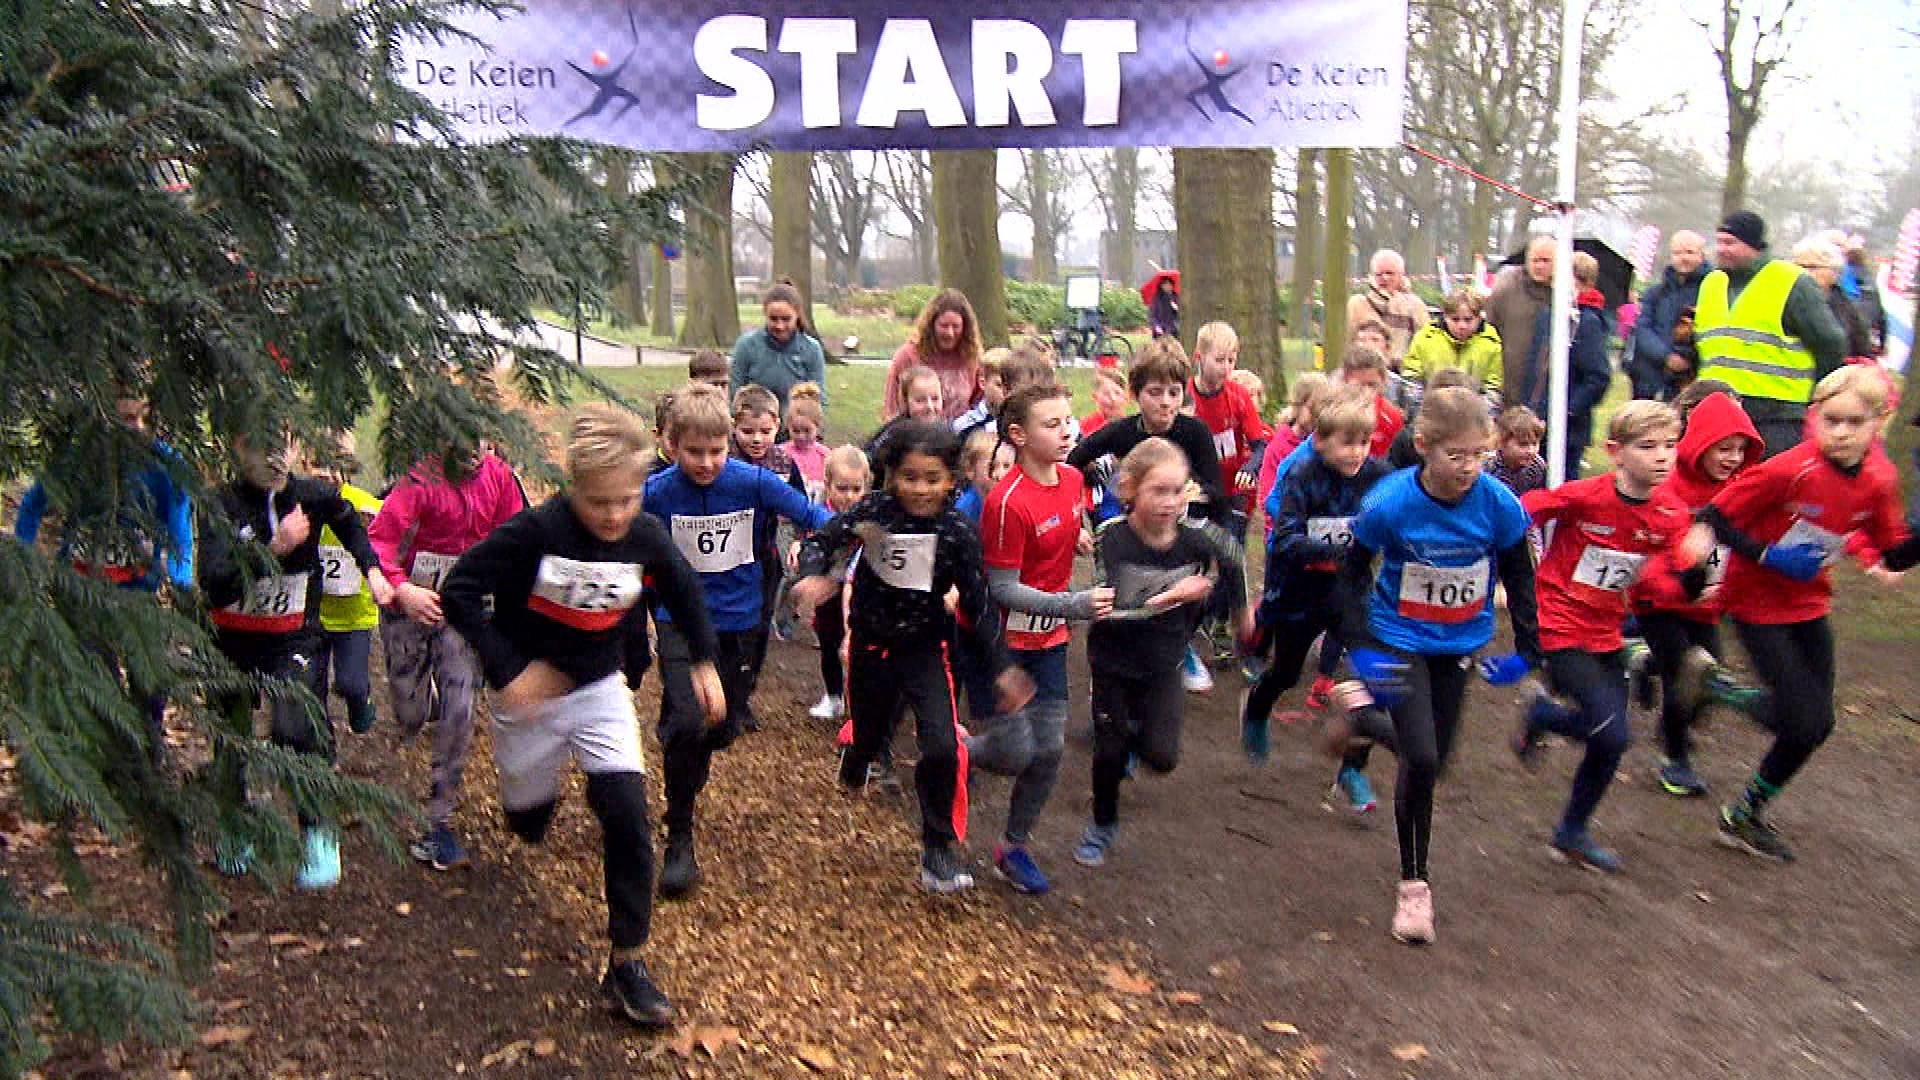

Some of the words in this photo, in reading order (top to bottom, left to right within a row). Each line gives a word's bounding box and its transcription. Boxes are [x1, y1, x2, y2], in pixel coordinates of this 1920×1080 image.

[416, 59, 457, 86] De
[469, 60, 555, 88] Keien
[693, 14, 1138, 130] START
[1267, 61, 1301, 87] De
[1312, 61, 1389, 87] Keien
[439, 97, 529, 125] tletiek
[1266, 96, 1361, 122] Atletiek
[697, 528, 732, 555] 67
[1420, 580, 1476, 608] 106
